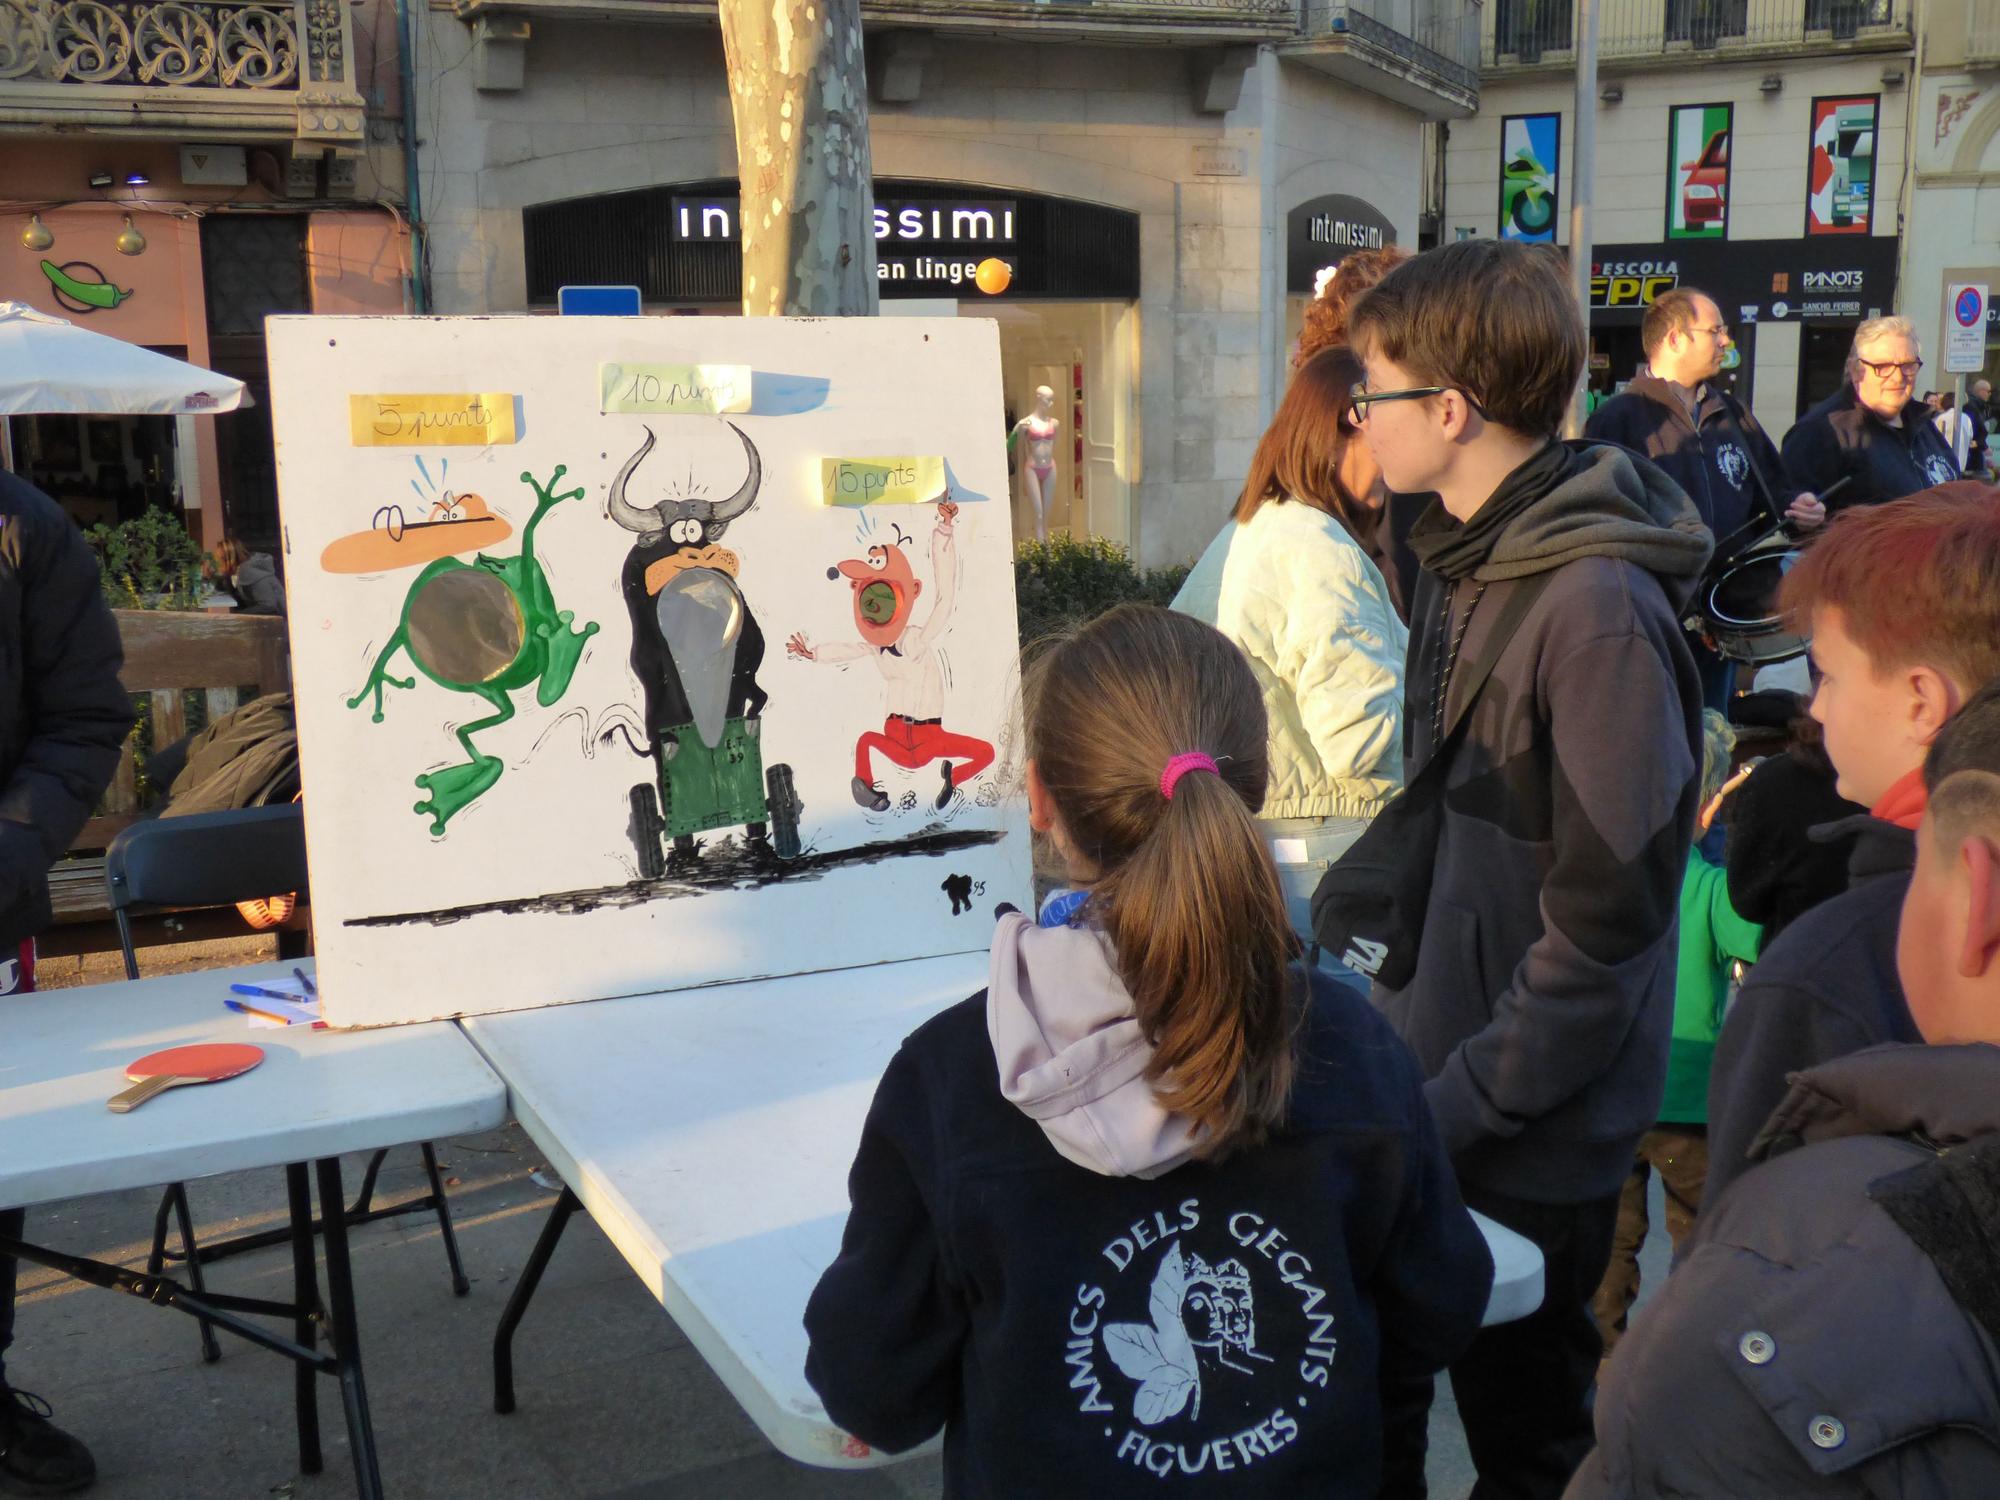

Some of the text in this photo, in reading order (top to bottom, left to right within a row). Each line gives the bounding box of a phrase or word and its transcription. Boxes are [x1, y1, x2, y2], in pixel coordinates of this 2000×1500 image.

[679, 207, 1013, 239] inssimi
[1311, 213, 1383, 250] intimissimi
[916, 257, 1013, 284] linge
[1803, 271, 1863, 286] PANOT3
[622, 374, 736, 406] 10 punts
[373, 398, 493, 438] 5 punts
[827, 463, 916, 500] 15 punts
[729, 752, 744, 764] 39
[1065, 1199, 1338, 1412] AMICS DELS GEGANTS
[1117, 1408, 1298, 1478] FIGUERES
